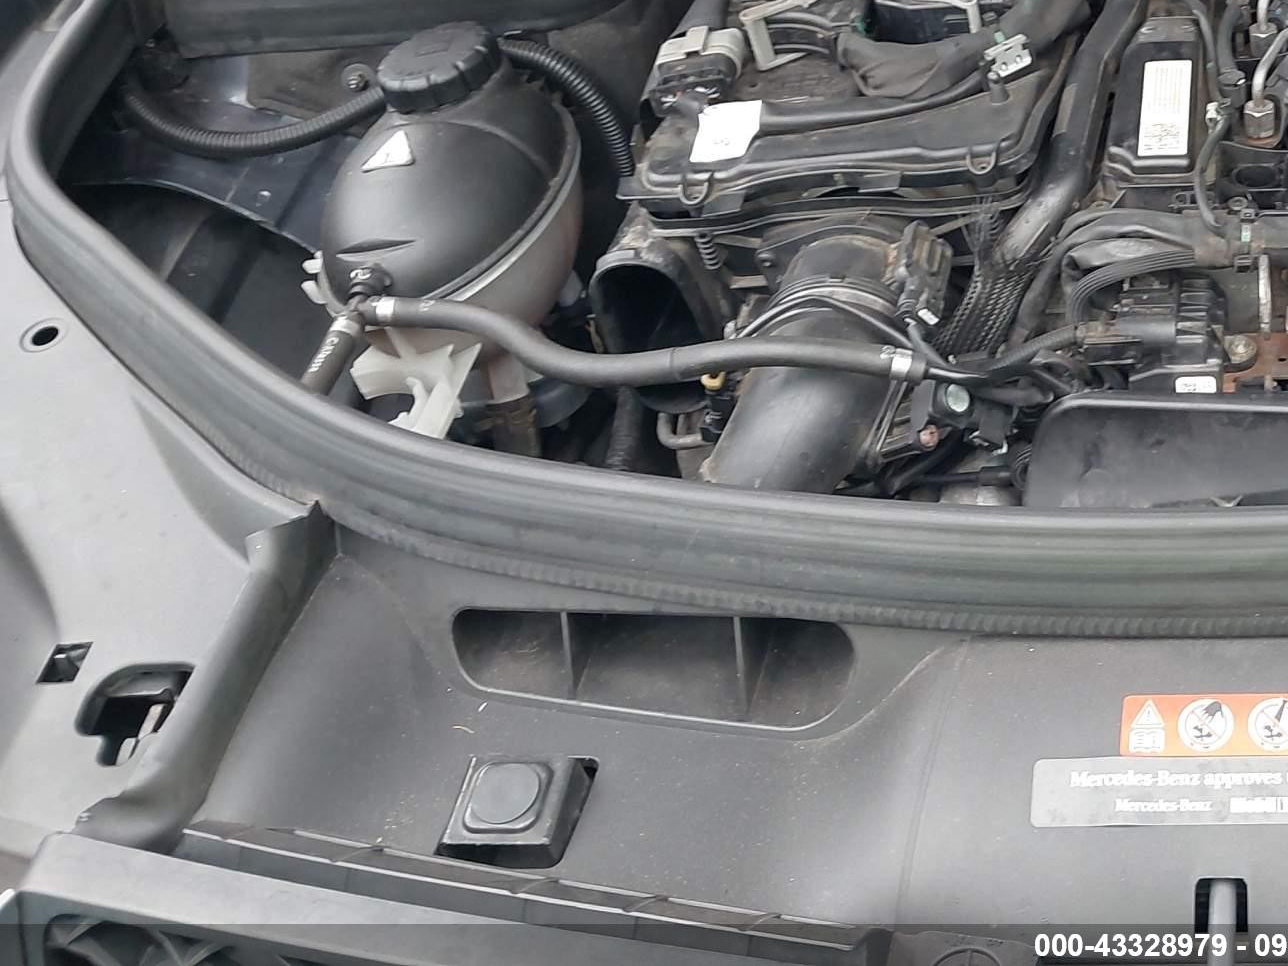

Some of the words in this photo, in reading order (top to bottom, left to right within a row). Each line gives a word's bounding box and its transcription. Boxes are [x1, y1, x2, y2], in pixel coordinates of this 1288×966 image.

[1070, 769, 1201, 788] Mercedes-Benz
[1203, 772, 1283, 790] approves
[1115, 798, 1213, 813] Mercedes-Benz
